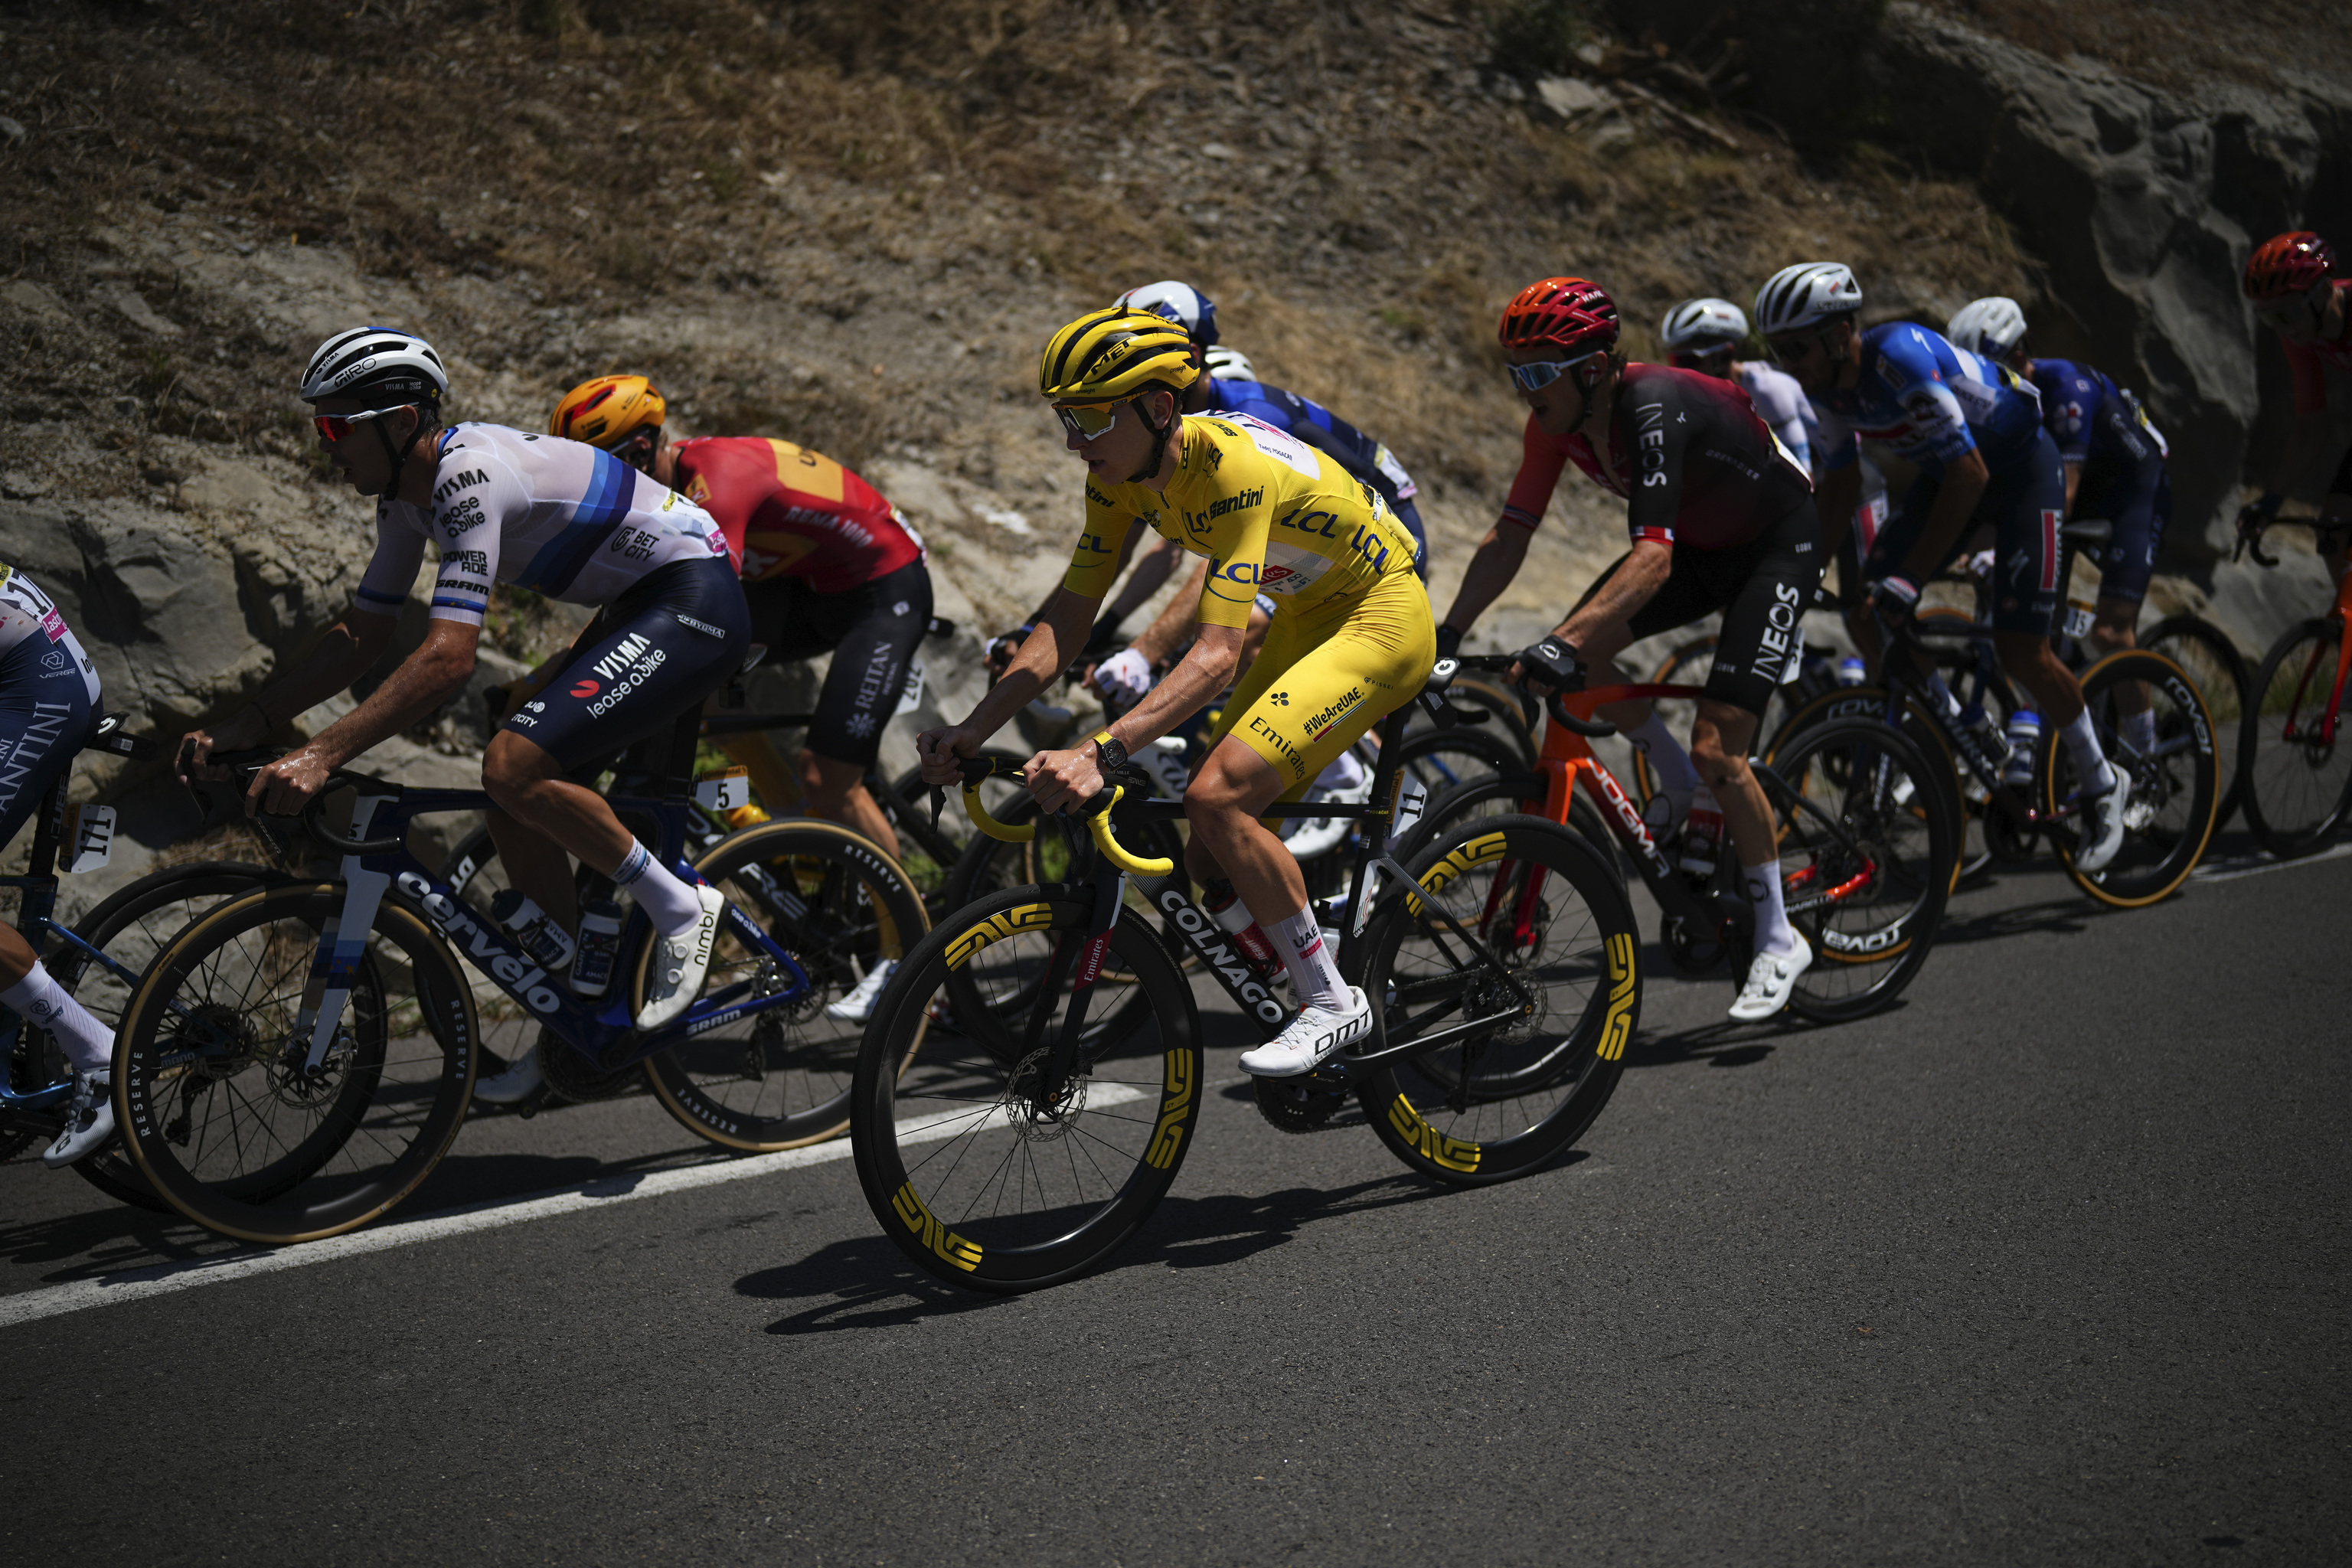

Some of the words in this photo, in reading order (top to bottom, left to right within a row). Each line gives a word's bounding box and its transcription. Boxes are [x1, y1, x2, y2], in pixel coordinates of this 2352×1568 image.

[322, 353, 339, 368] VISMA
[335, 358, 377, 387] GIRO
[1089, 337, 1131, 376] MET
[385, 383, 404, 391] VISMA
[1635, 401, 1668, 488] INEOS
[433, 469, 491, 504] VISMA
[438, 495, 480, 528] lease
[447, 511, 485, 538] abike
[782, 505, 841, 530] REMA
[837, 519, 875, 548] 1000
[1279, 508, 1338, 539] LCL
[443, 550, 488, 564] POWER
[624, 545, 655, 562] CITY
[633, 530, 660, 547] BET
[1351, 524, 1390, 576] LCL
[435, 578, 490, 596] SRAM
[461, 561, 488, 577] ADE
[1209, 557, 1263, 586] LCL
[1750, 581, 1800, 684] INEOS
[38, 668, 76, 679] VERGE
[593, 632, 651, 681] VISMA
[854, 640, 893, 710] REITAN
[586, 681, 632, 720] lease
[629, 648, 667, 687] abike
[1303, 687, 1362, 737] #WeAreUAE
[2165, 676, 2213, 756] roval
[1249, 716, 1306, 780] Emirates
[717, 783, 730, 808] 5
[1400, 792, 1425, 819] 11
[79, 818, 112, 857] 171
[844, 844, 902, 893] RESERVE
[694, 910, 714, 966] nimbl
[1292, 923, 1318, 949] UAE
[1353, 926, 1366, 939] UAE
[1083, 938, 1104, 982] Emirates
[1161, 890, 1283, 1024] COLNAGO
[450, 1000, 466, 1080] RESERVE
[686, 1008, 742, 1036] SRAM
[129, 1051, 150, 1138] RESERVE
[676, 1087, 739, 1135] RESERVE
